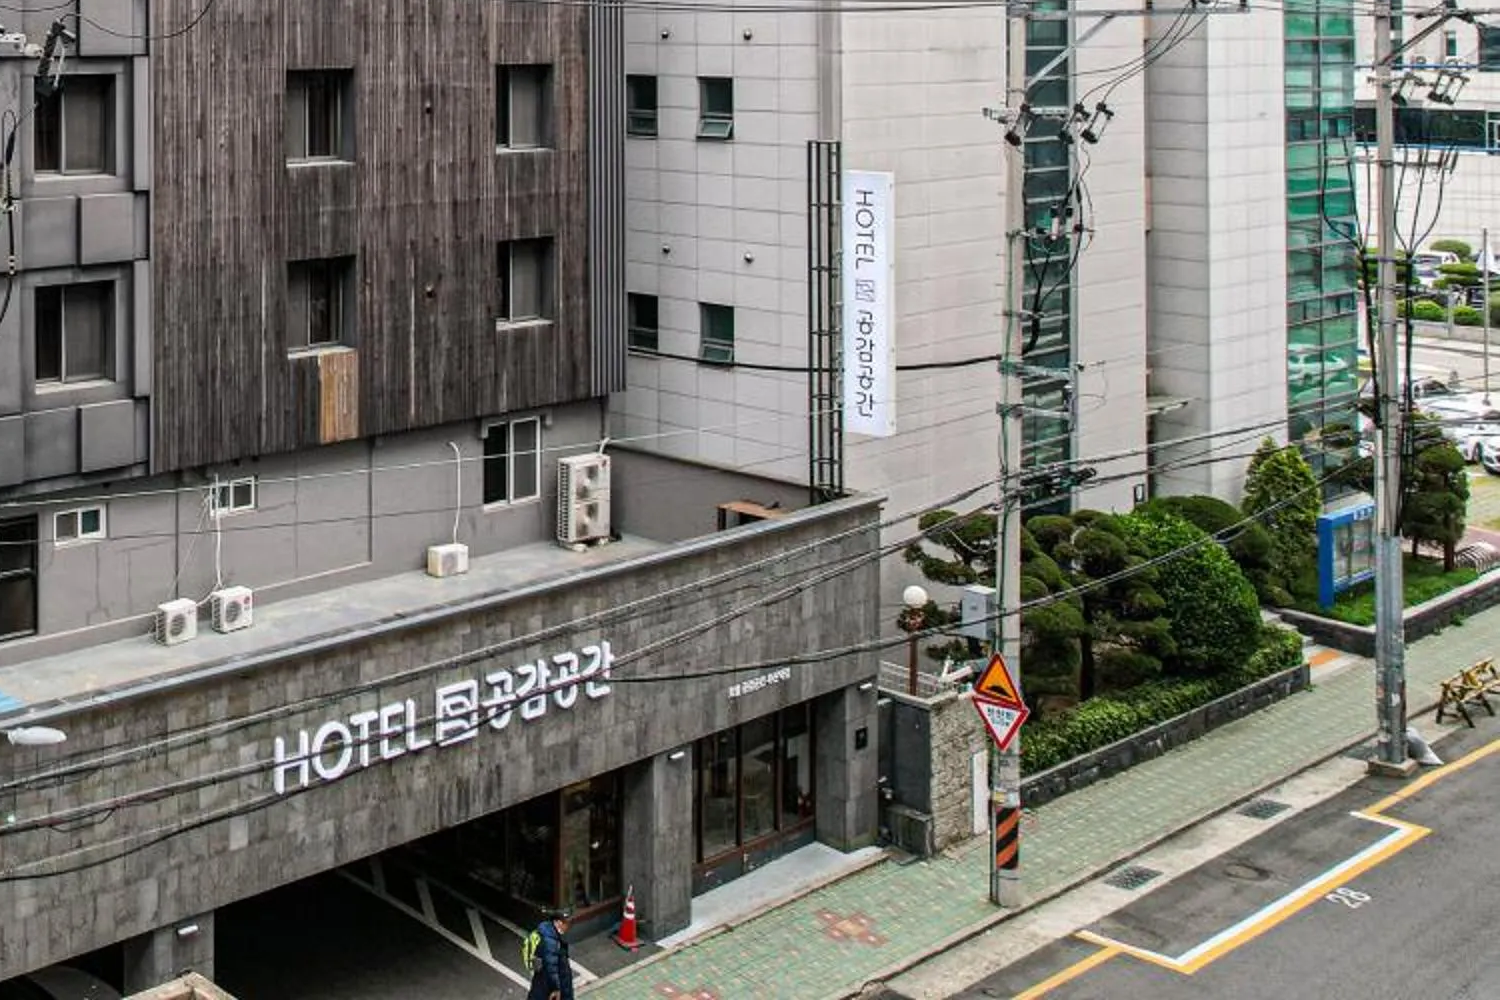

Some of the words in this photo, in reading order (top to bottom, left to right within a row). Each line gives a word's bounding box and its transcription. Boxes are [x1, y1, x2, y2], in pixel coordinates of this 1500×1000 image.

[855, 189, 875, 270] HOTEL
[855, 308, 874, 418] 공감공간
[273, 698, 432, 795] HOTEL
[481, 640, 615, 730] 공감공간
[1325, 887, 1372, 909] 28
